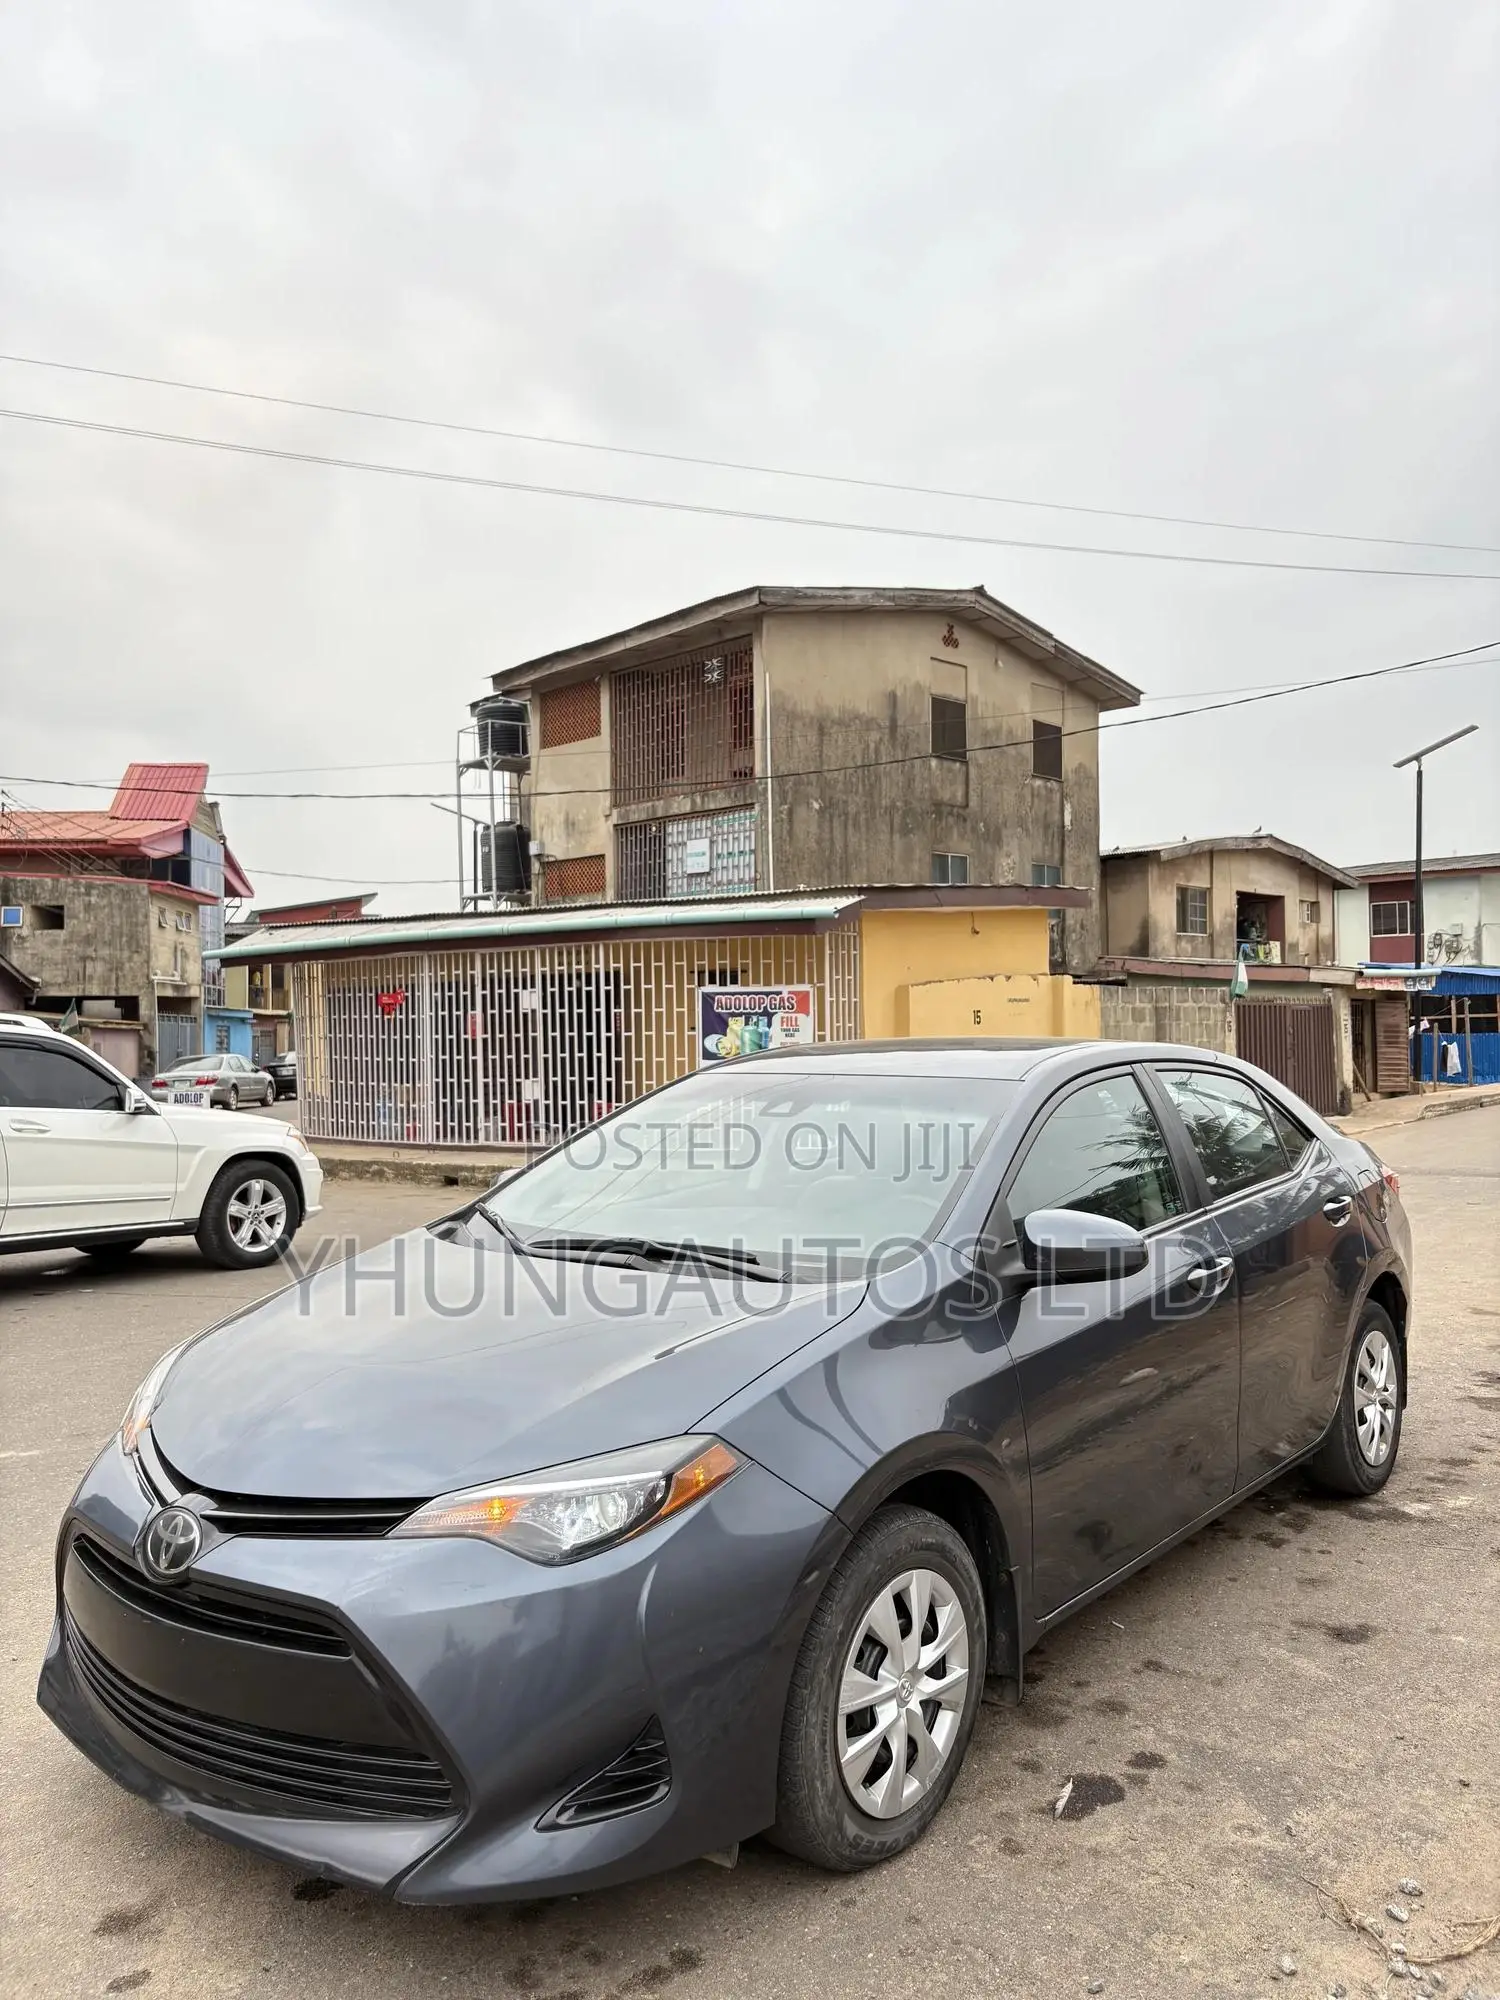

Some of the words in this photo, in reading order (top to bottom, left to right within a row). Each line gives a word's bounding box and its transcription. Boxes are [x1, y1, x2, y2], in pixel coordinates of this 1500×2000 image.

[715, 995, 767, 1011] ADOLOP
[768, 995, 796, 1011] GAS
[780, 1015, 800, 1028] FILL
[973, 1009, 982, 1025] 15
[173, 1092, 205, 1105] ADOLOP
